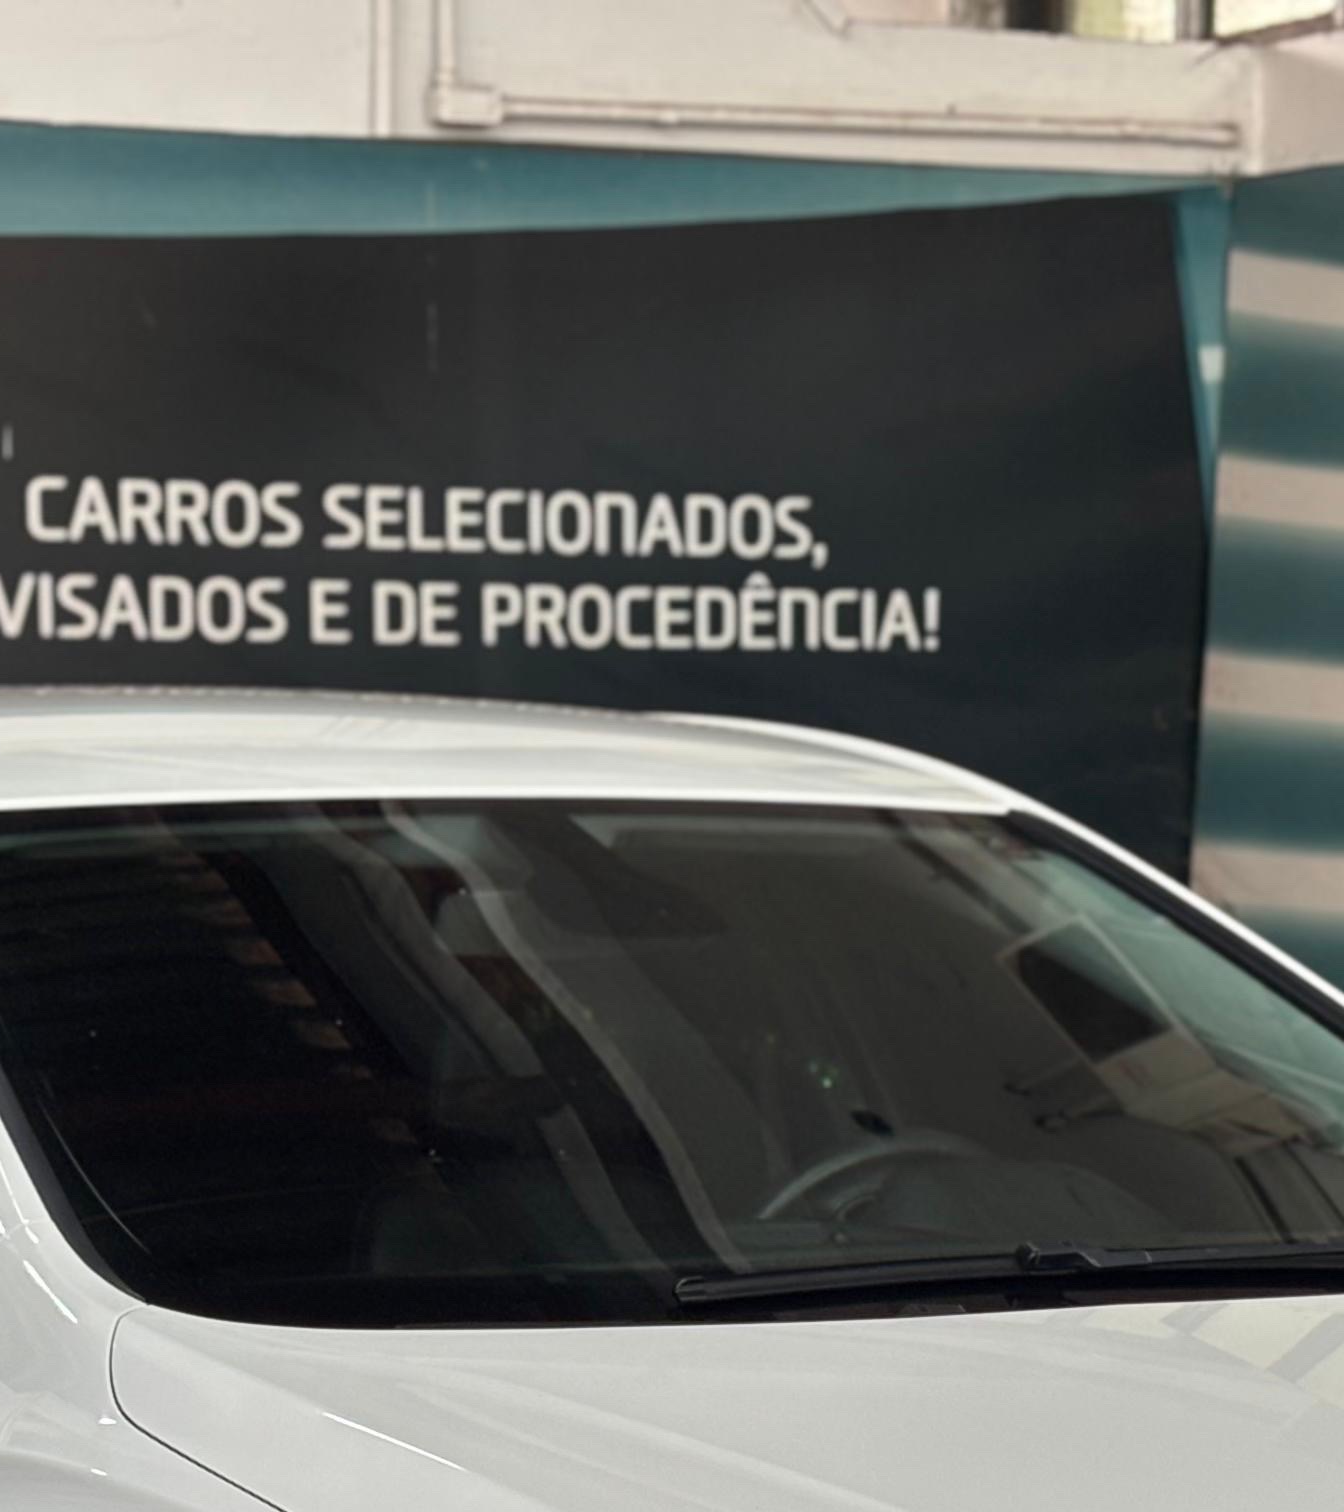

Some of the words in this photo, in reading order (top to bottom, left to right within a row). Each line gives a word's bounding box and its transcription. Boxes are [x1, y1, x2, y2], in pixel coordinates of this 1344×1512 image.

[25, 475, 304, 548] CARROS
[323, 484, 829, 569] SELECIONADOS,
[308, 578, 352, 644] E
[372, 580, 460, 646] DE
[480, 571, 941, 651] PROCEDÊNCIA!
